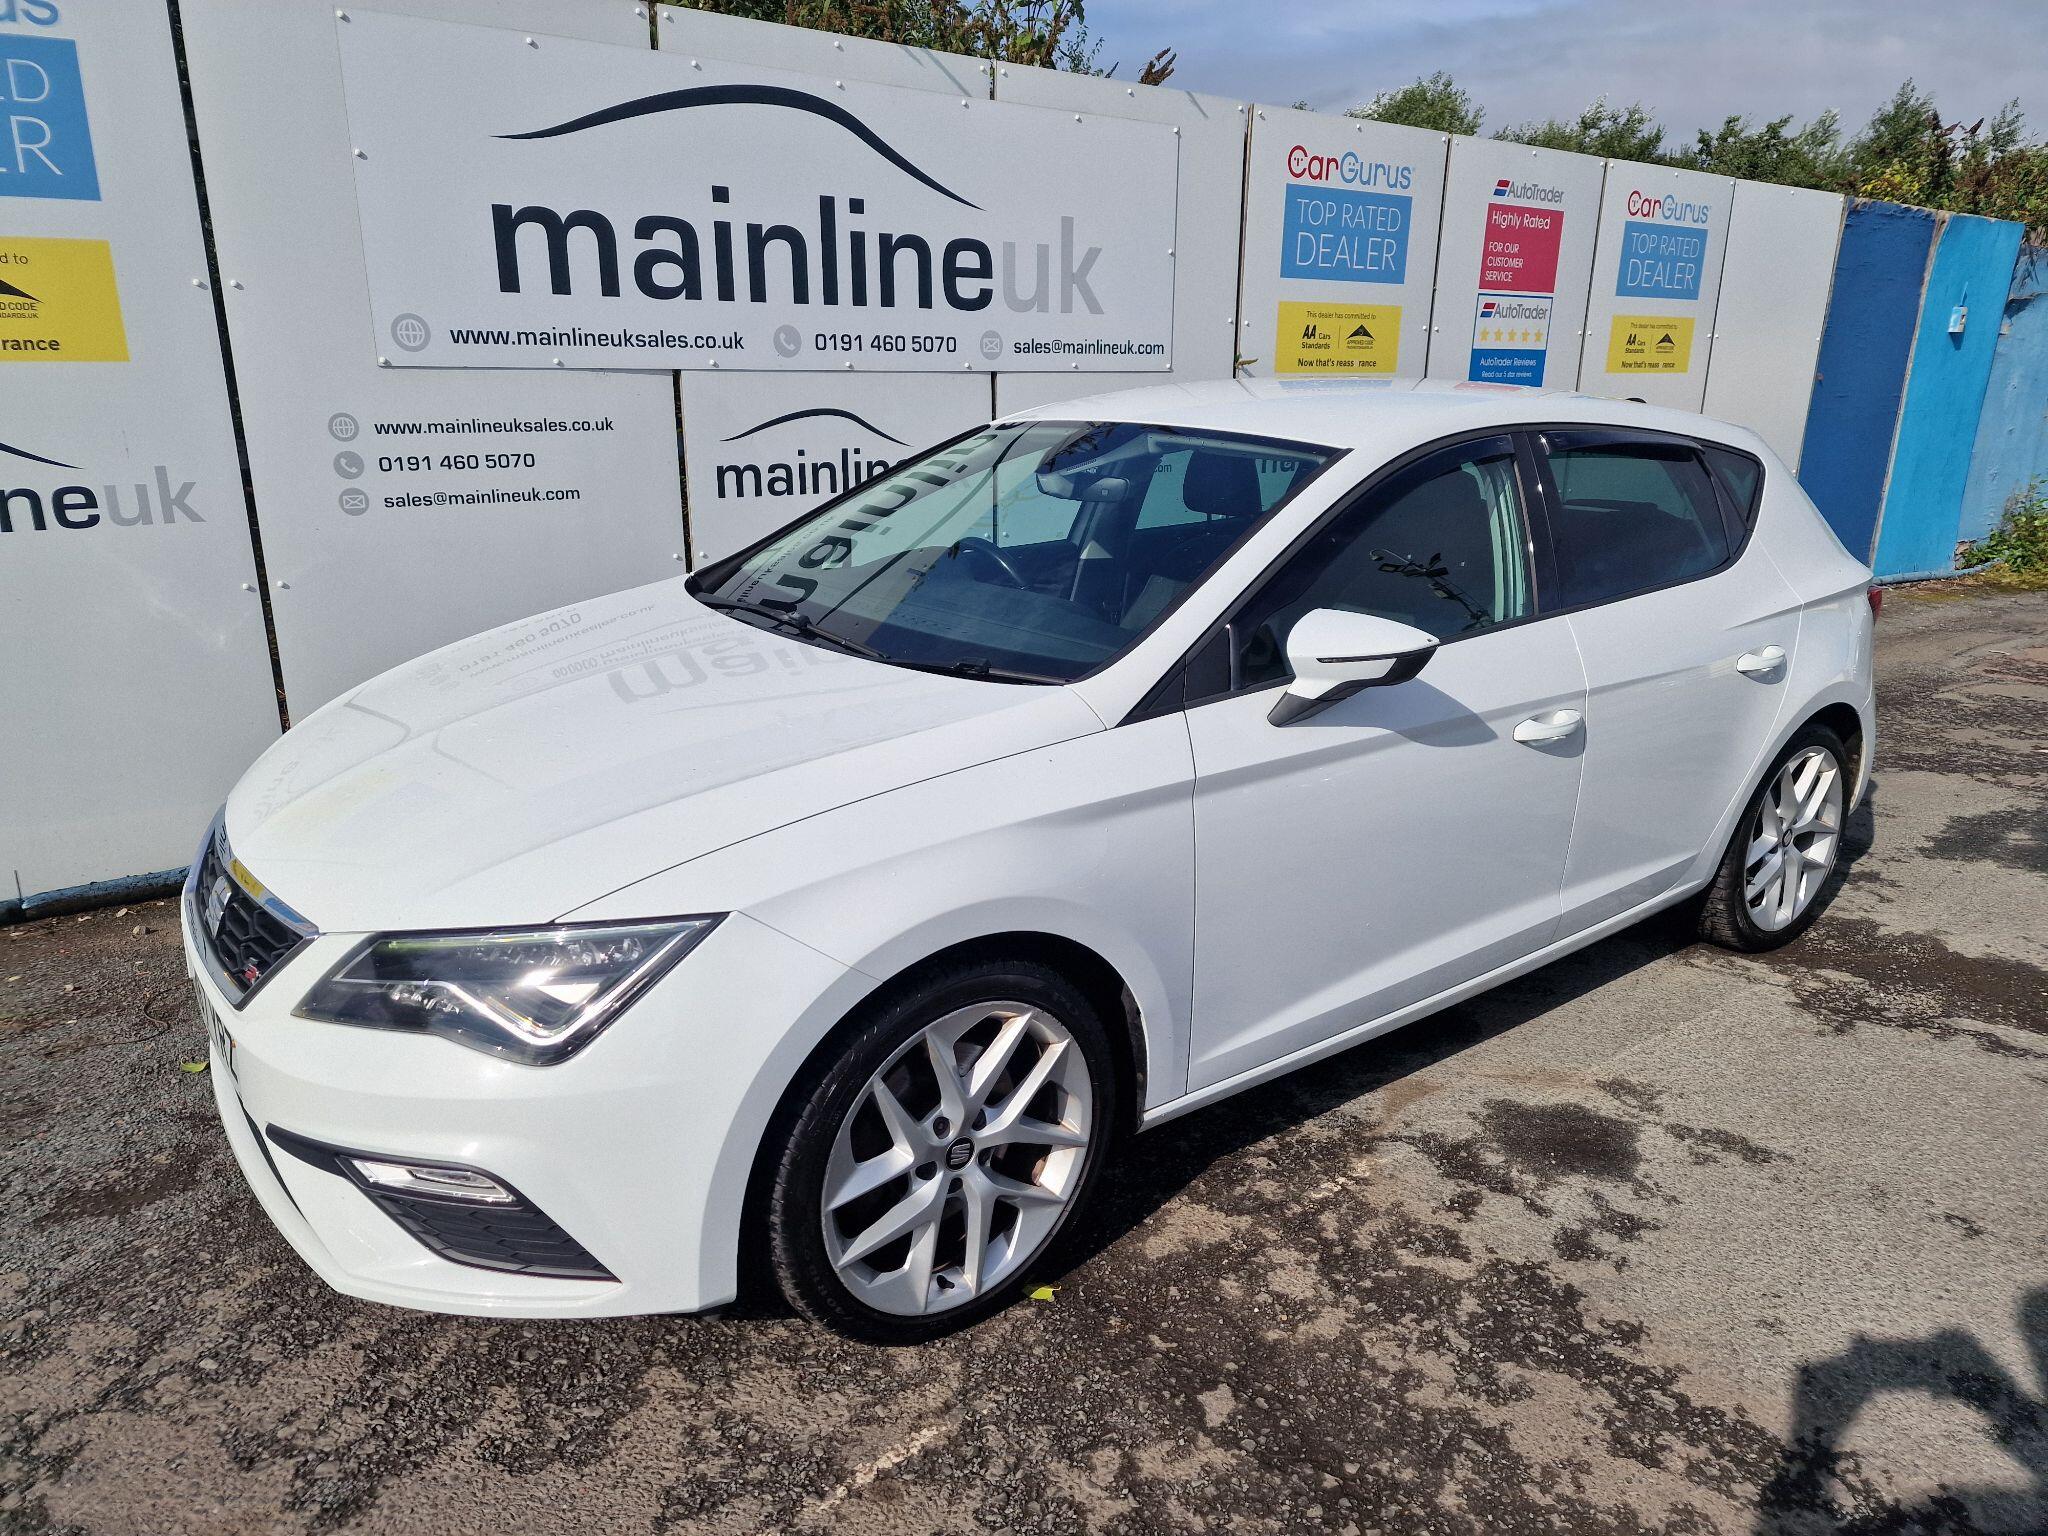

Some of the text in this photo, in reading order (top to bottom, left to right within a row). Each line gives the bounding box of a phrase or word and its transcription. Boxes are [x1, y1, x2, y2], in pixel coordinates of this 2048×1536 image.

[1287, 145, 1412, 189] CarGurus
[1507, 181, 1565, 204] AutoTrader
[1297, 198, 1401, 232] TOP RATED
[1627, 190, 1710, 224] CarGurus
[1491, 210, 1551, 230] Highly Rated
[491, 185, 1105, 314] mainlineuk
[1296, 231, 1396, 271] DEALER
[1488, 241, 1520, 254] FOR OUR
[1631, 232, 1700, 258] TOP RATED
[13, 253, 29, 265] to
[1487, 256, 1524, 269] CUSTOMER
[1485, 270, 1513, 282] SERVICE
[1626, 258, 1696, 290] DEALER
[1493, 303, 1548, 320] AutoTrader
[450, 327, 745, 350] www.mainlineuksales.co.uk
[1302, 324, 1331, 340] AA Cars
[814, 332, 957, 353] 0191 460 5070
[1013, 337, 1165, 355] sales@mainlineuk.com
[1301, 341, 1331, 350] Standards
[1297, 358, 1314, 367] Now
[1315, 358, 1335, 367] that's
[1480, 357, 1537, 367] AutoTrader Reviews
[1620, 360, 1633, 369] Now
[374, 417, 614, 435] www.mainlineuksales.co.uk
[378, 452, 535, 472] 0191 460 5070
[384, 487, 581, 508] sales@mainlineuk.com
